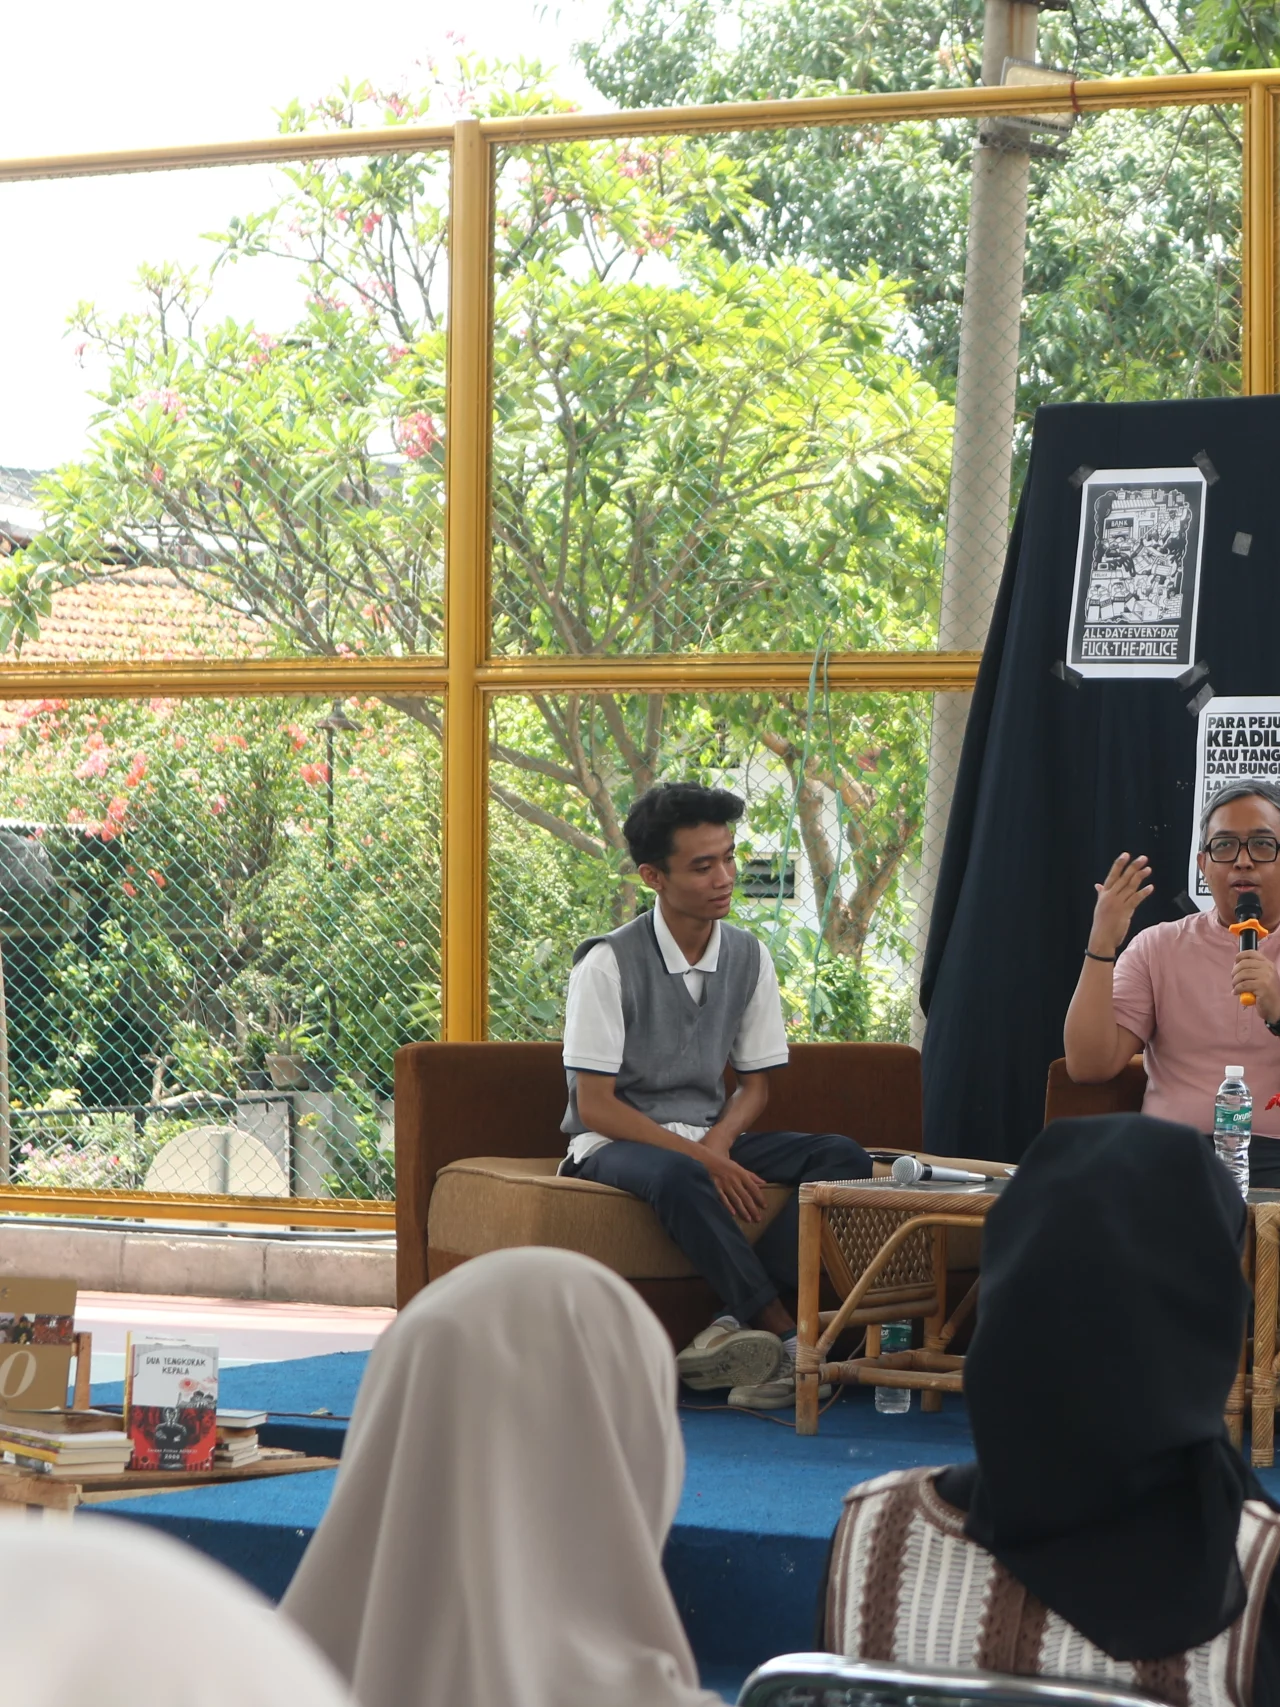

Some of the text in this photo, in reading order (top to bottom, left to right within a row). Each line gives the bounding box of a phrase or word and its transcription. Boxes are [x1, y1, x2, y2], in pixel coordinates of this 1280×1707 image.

[1083, 628, 1178, 638] ALL DAY EVERY DAY
[1082, 642, 1178, 656] FUCK THE POLICE
[1208, 716, 1246, 728] PARA
[1207, 749, 1238, 762] KAU
[1206, 762, 1236, 774] DAN
[146, 1356, 206, 1366] DUA TENGKORAK
